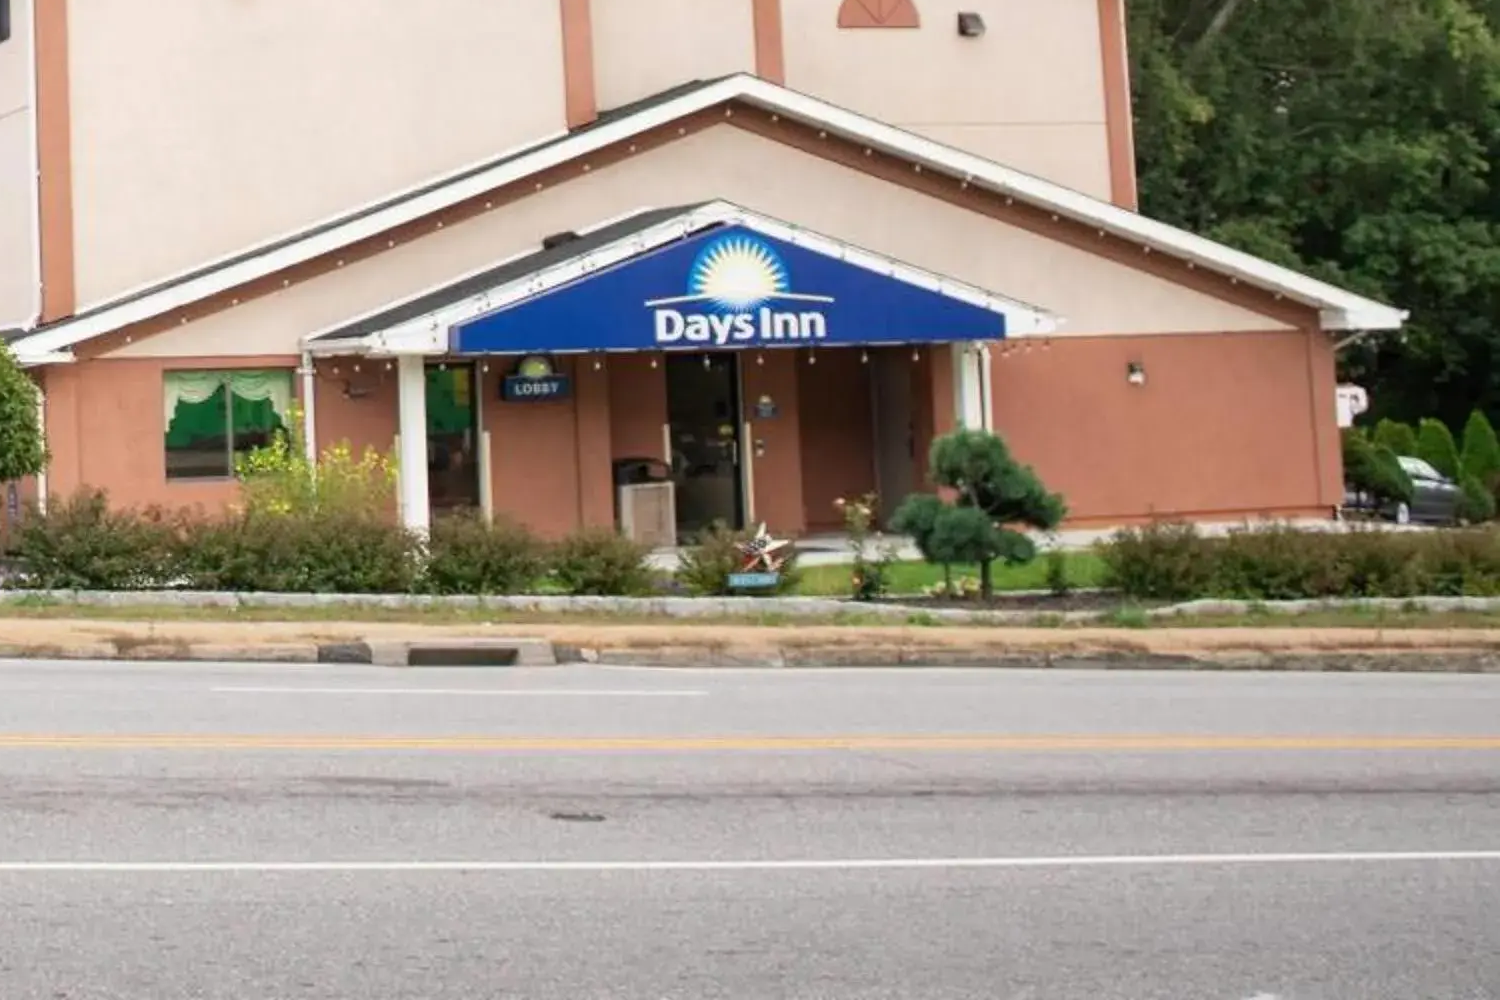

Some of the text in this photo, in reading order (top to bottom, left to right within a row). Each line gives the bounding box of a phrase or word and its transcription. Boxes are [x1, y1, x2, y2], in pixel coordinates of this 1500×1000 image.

[654, 307, 827, 345] Days Inn
[515, 382, 560, 396] LOBBY
